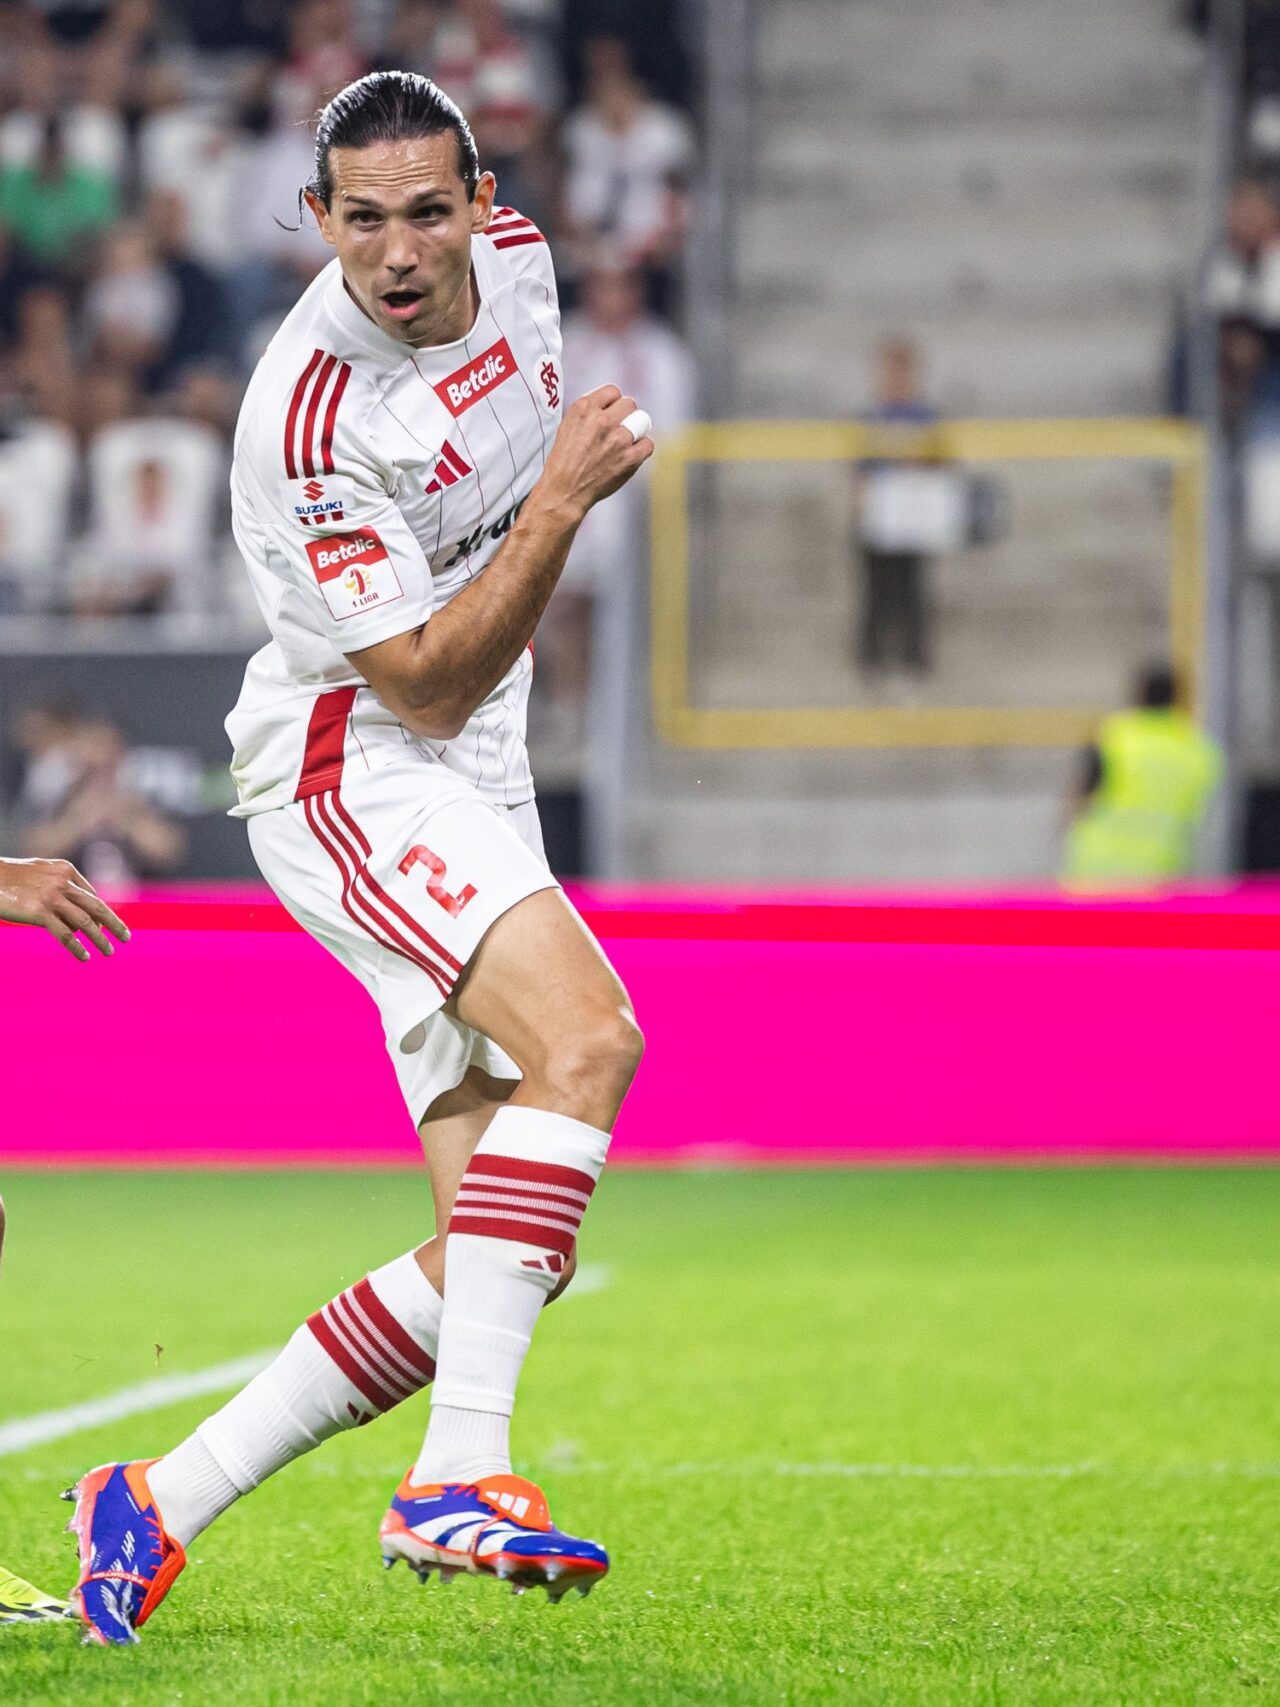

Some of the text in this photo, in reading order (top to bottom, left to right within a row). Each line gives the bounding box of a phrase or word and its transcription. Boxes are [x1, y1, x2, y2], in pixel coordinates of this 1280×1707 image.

[446, 354, 506, 408] Betclic
[294, 500, 343, 515] SUZUKI
[316, 538, 376, 570] Betclic
[352, 592, 380, 608] 1 LIGA
[397, 844, 479, 919] 2
